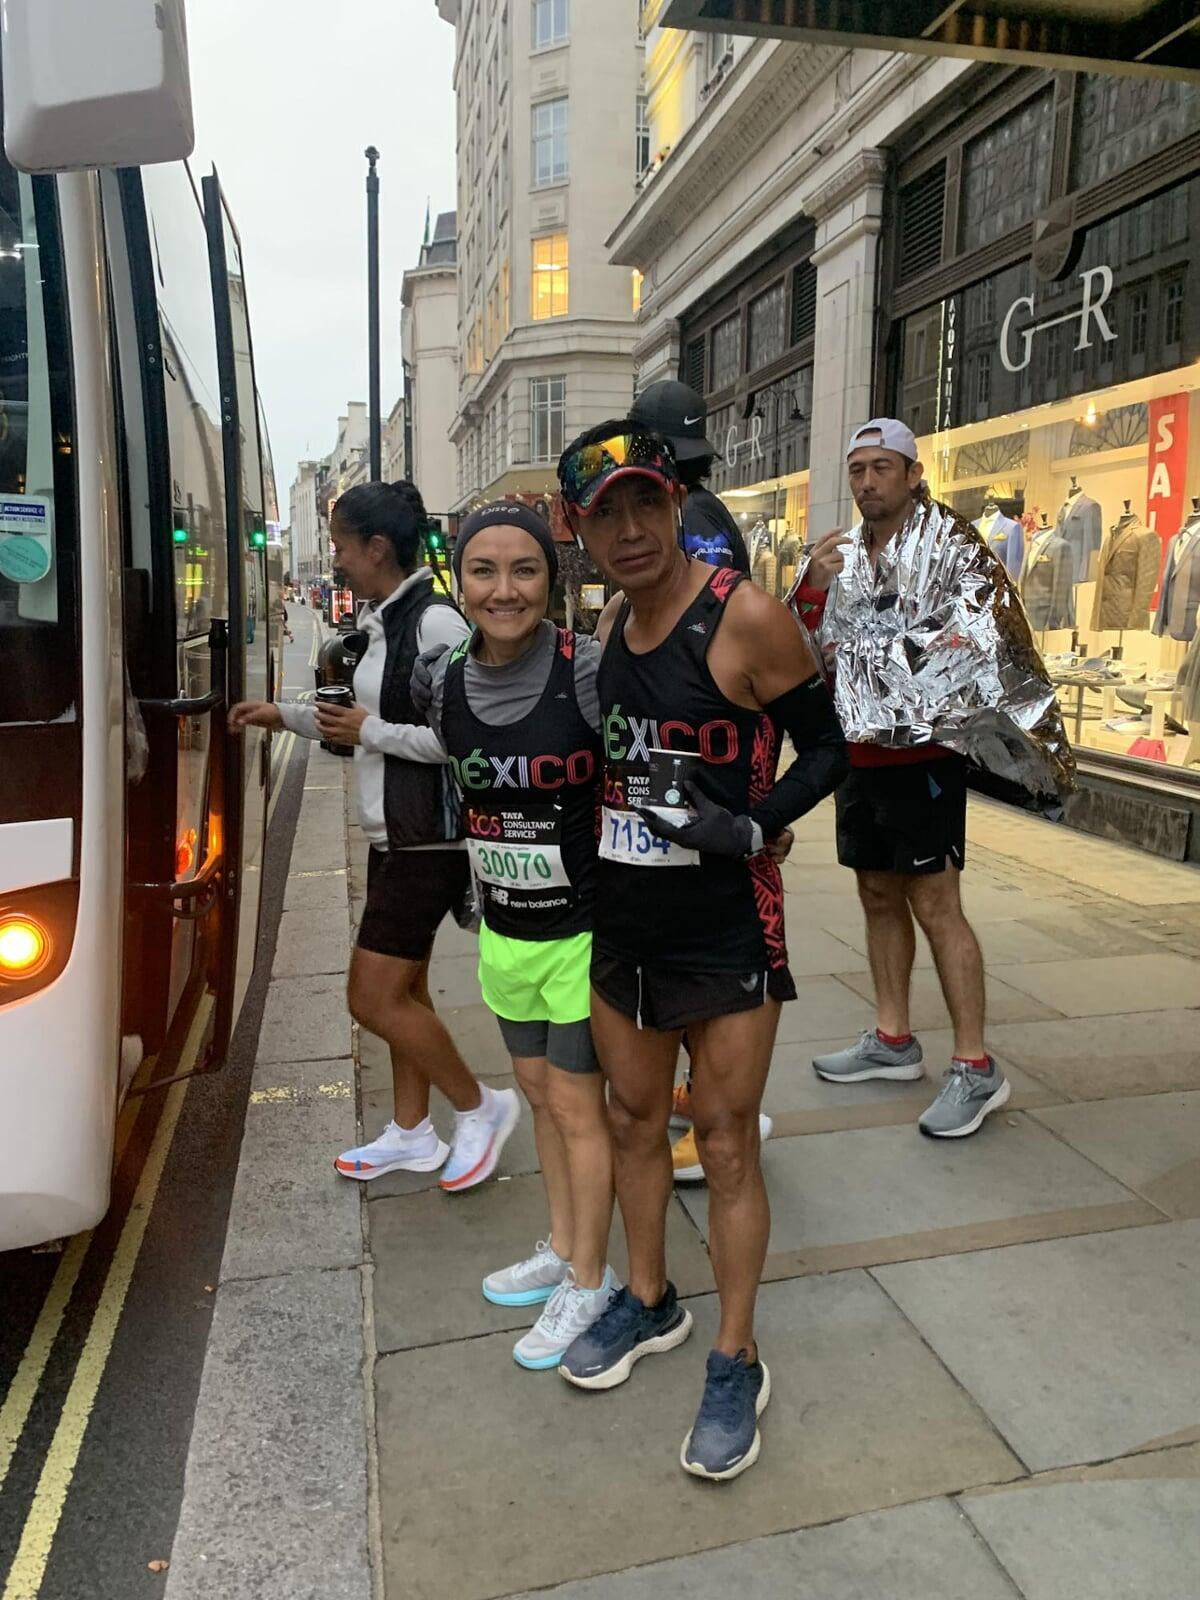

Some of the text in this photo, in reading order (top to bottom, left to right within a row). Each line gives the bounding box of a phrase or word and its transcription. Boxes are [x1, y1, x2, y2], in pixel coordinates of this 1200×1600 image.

[601, 704, 739, 764] ÉXICO
[501, 812, 524, 820] TATA
[468, 808, 501, 837] tcs
[502, 820, 556, 831] CONSULTANCY
[504, 830, 537, 839] SERVICES
[478, 847, 552, 881] 30070
[510, 897, 568, 909] new balance
